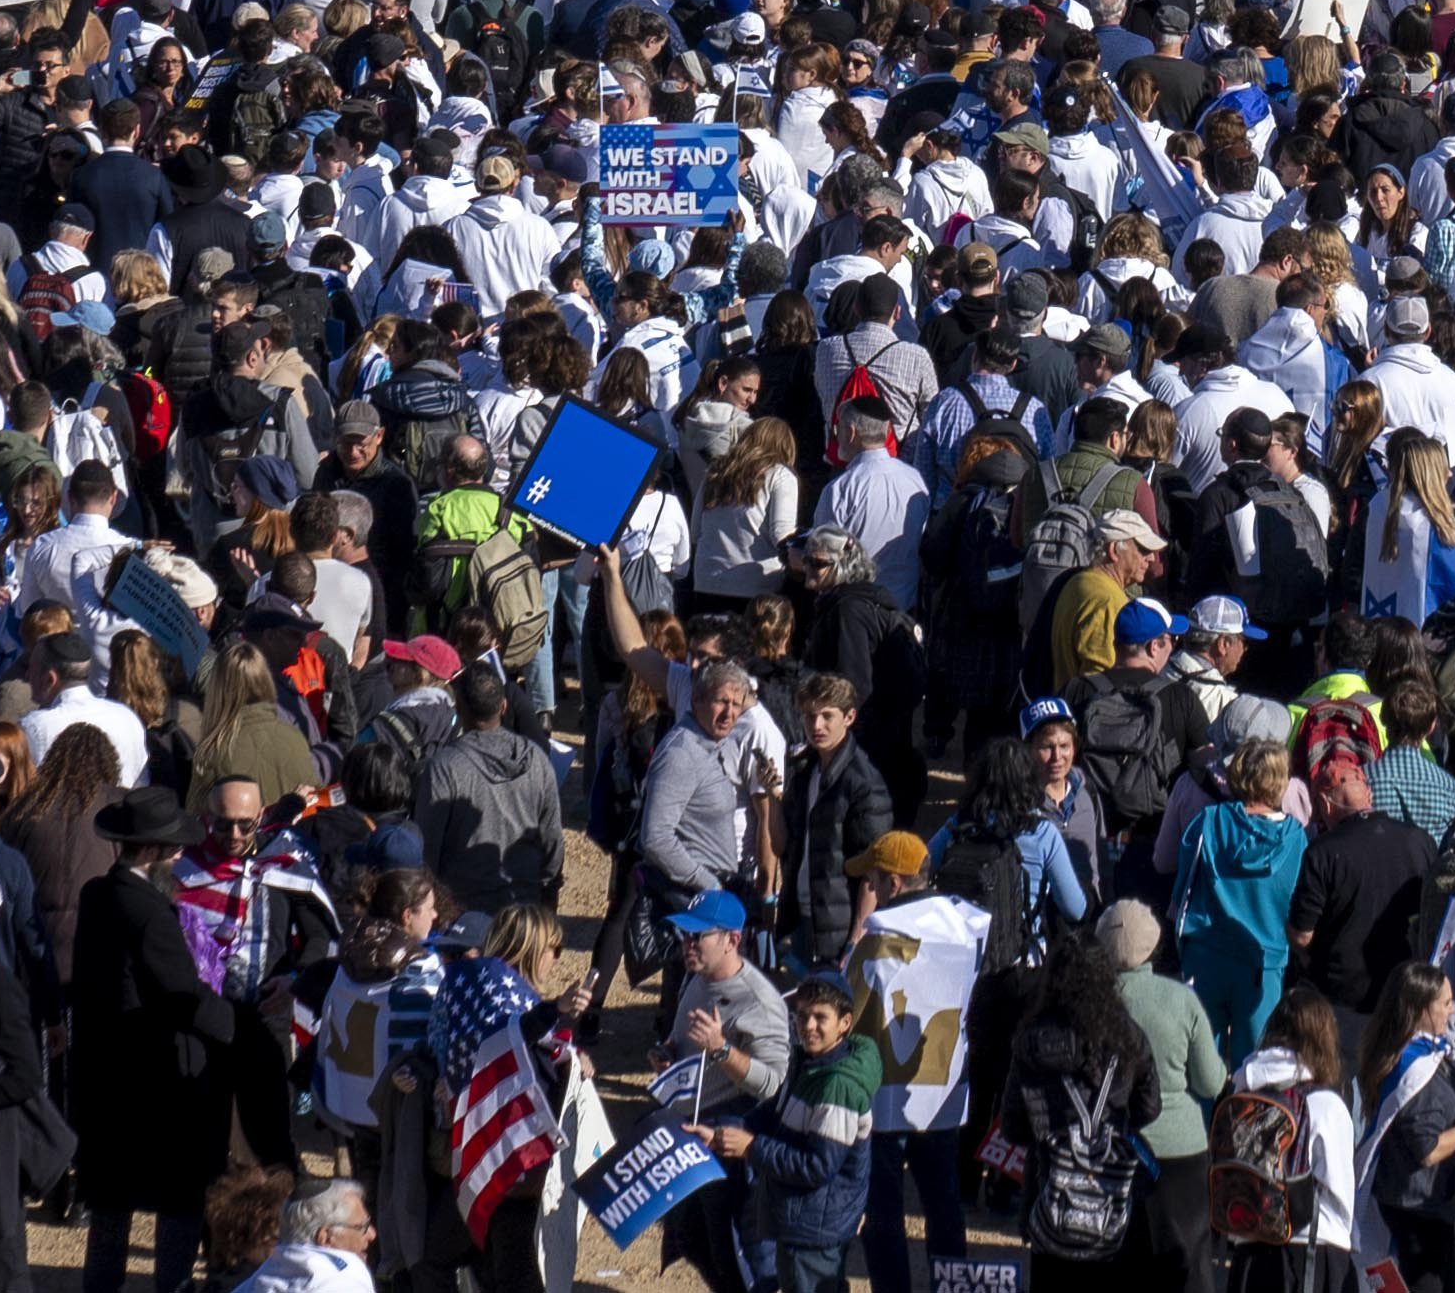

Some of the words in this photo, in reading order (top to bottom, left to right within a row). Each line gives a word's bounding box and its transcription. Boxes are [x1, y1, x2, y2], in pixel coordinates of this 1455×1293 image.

[607, 147, 644, 167] WE
[650, 146, 728, 167] STAND
[607, 170, 662, 188] WITH
[607, 192, 704, 217] ISRAEL
[525, 474, 552, 506] #
[602, 1171, 619, 1193] I
[613, 1126, 676, 1184] STAND
[599, 1184, 651, 1231] WITH
[645, 1141, 711, 1193] ISRAEL
[934, 1261, 1017, 1286] NEVER
